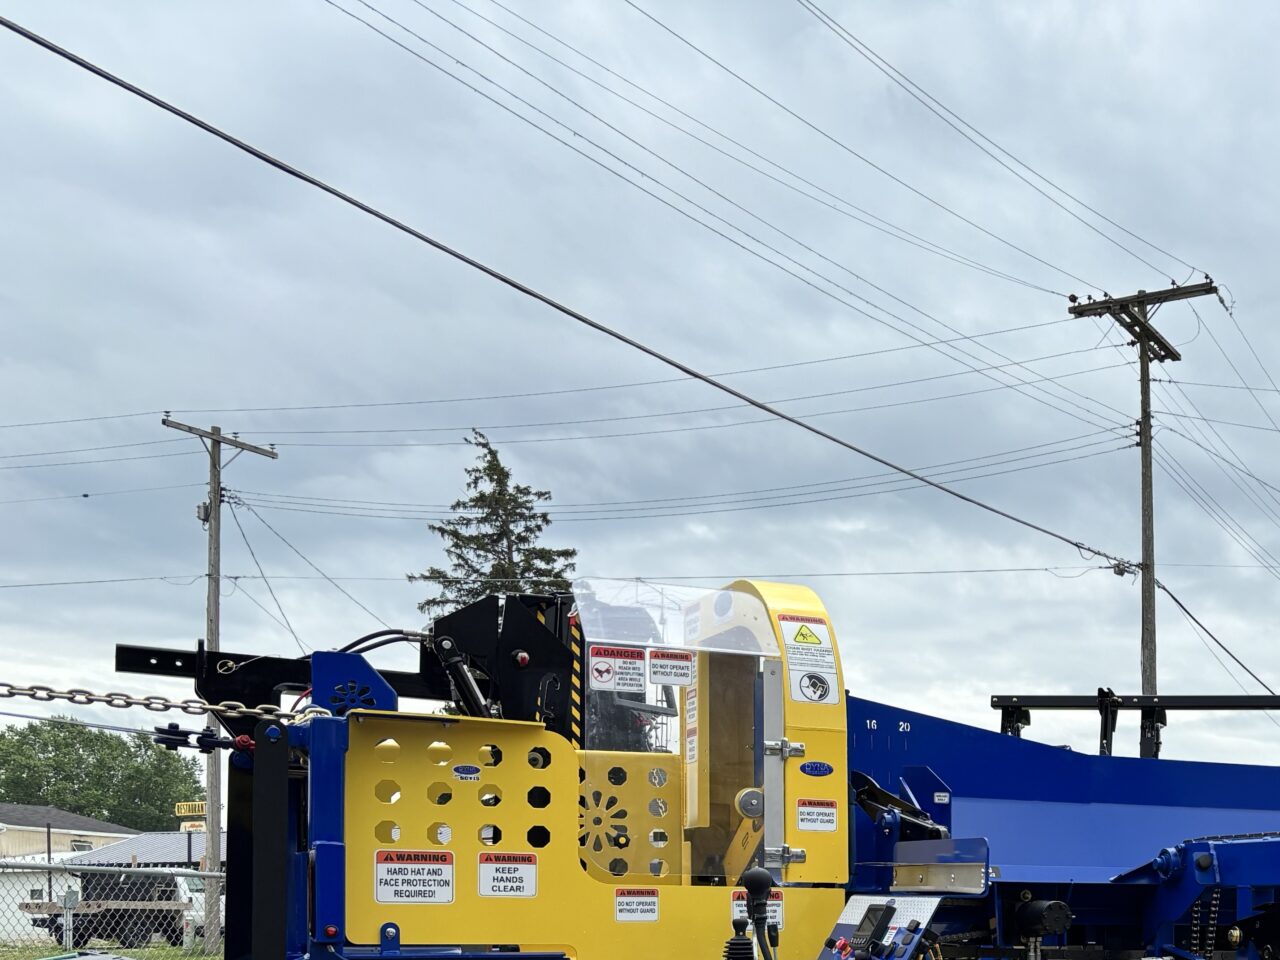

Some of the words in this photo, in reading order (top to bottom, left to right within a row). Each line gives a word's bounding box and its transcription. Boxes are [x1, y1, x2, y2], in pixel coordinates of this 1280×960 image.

[603, 650, 643, 659] DANGER
[866, 719, 878, 730] 16
[899, 722, 911, 732] 20
[395, 853, 447, 863] WARNING
[494, 855, 533, 863] WARNING
[386, 867, 409, 876] HARD
[411, 868, 425, 876] HAT
[427, 868, 443, 876] AND
[495, 866, 519, 875] KEEP
[379, 878, 400, 887] FACE
[401, 878, 450, 888] PROTECTION
[492, 876, 524, 884] HANDS
[491, 884, 525, 893] CLEAR!
[393, 889, 436, 899] REQUIRED!
